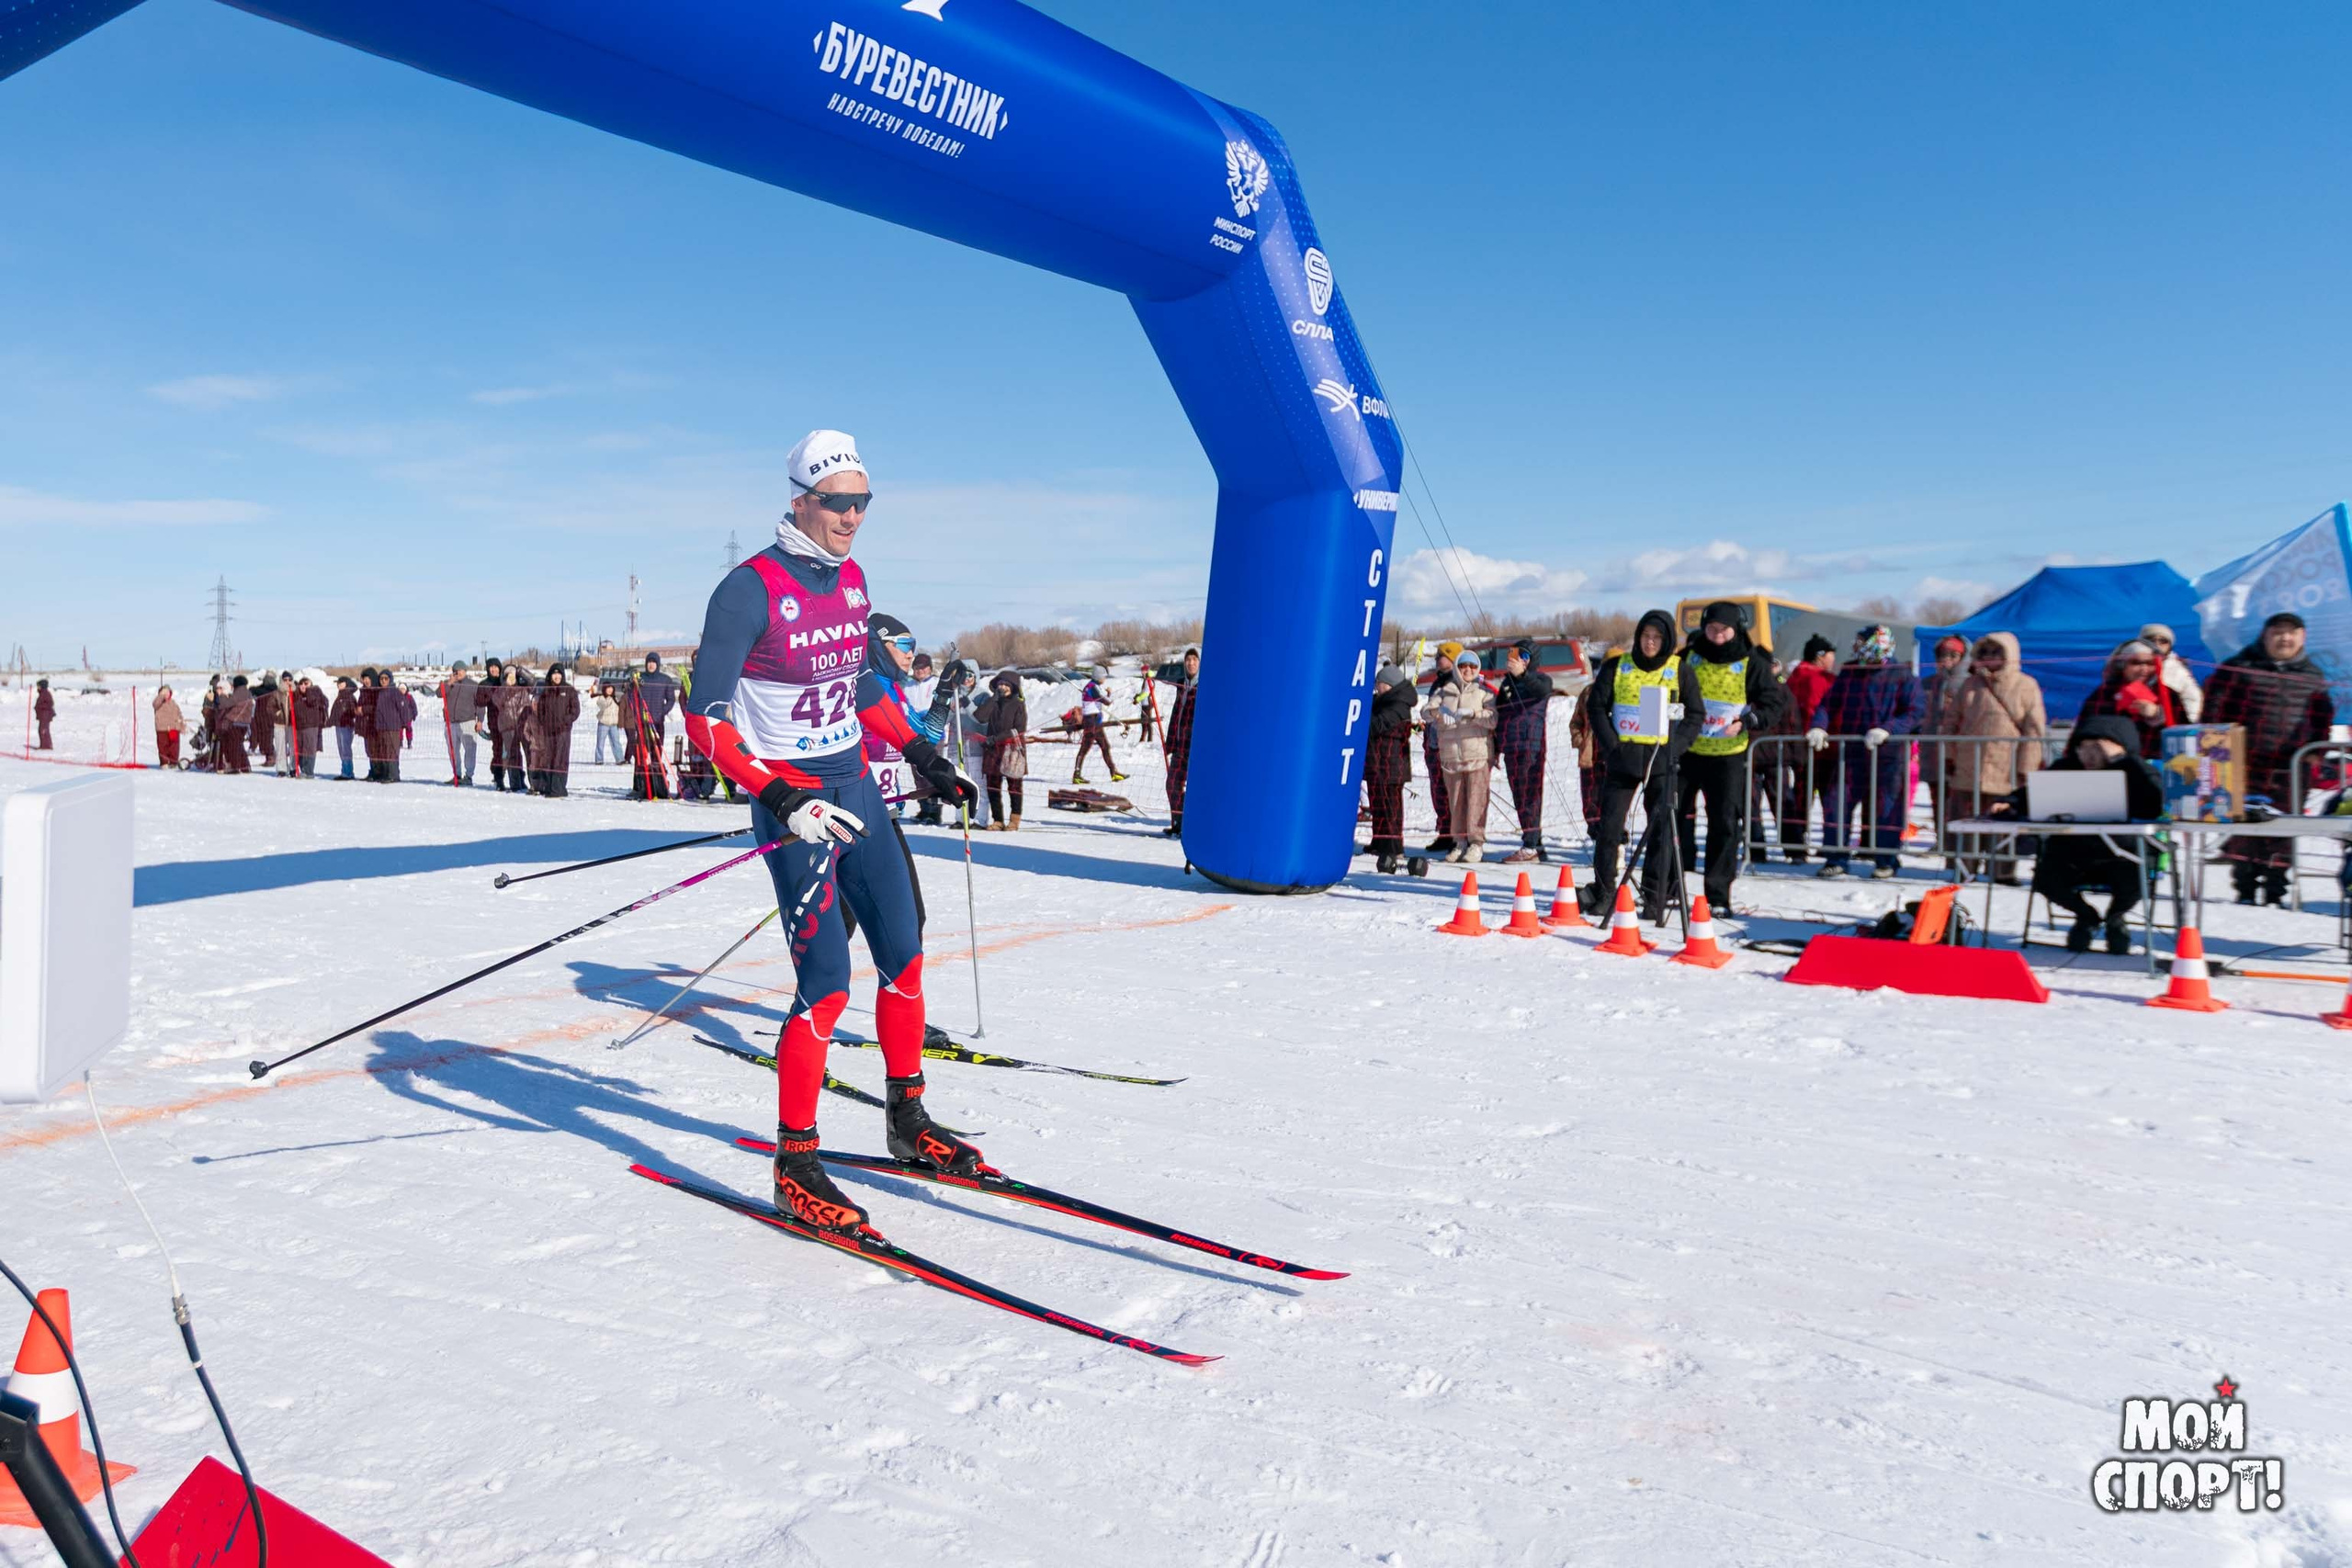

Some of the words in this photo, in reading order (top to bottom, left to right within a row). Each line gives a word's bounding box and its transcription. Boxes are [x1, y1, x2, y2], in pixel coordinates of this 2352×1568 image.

[819, 20, 1005, 141] БУРЕВЕСТНИК
[826, 92, 904, 135] НАВСТРЕЧУ
[901, 122, 966, 159] ПОБЕДАМ!
[1213, 216, 1257, 242] МИНСПОРТ
[1209, 233, 1244, 255] РОССИИ
[789, 619, 869, 649] HAVAL
[809, 651, 838, 671] 100
[841, 646, 864, 665] ЛЕТ
[1340, 548, 1383, 785] СТАРТ
[755, 1055, 778, 1069] FIS
[936, 1173, 983, 1190] ROSSIGNOL
[818, 1229, 862, 1252] ROSSIGNOL
[1170, 1233, 1232, 1258] ROSSIGNOL
